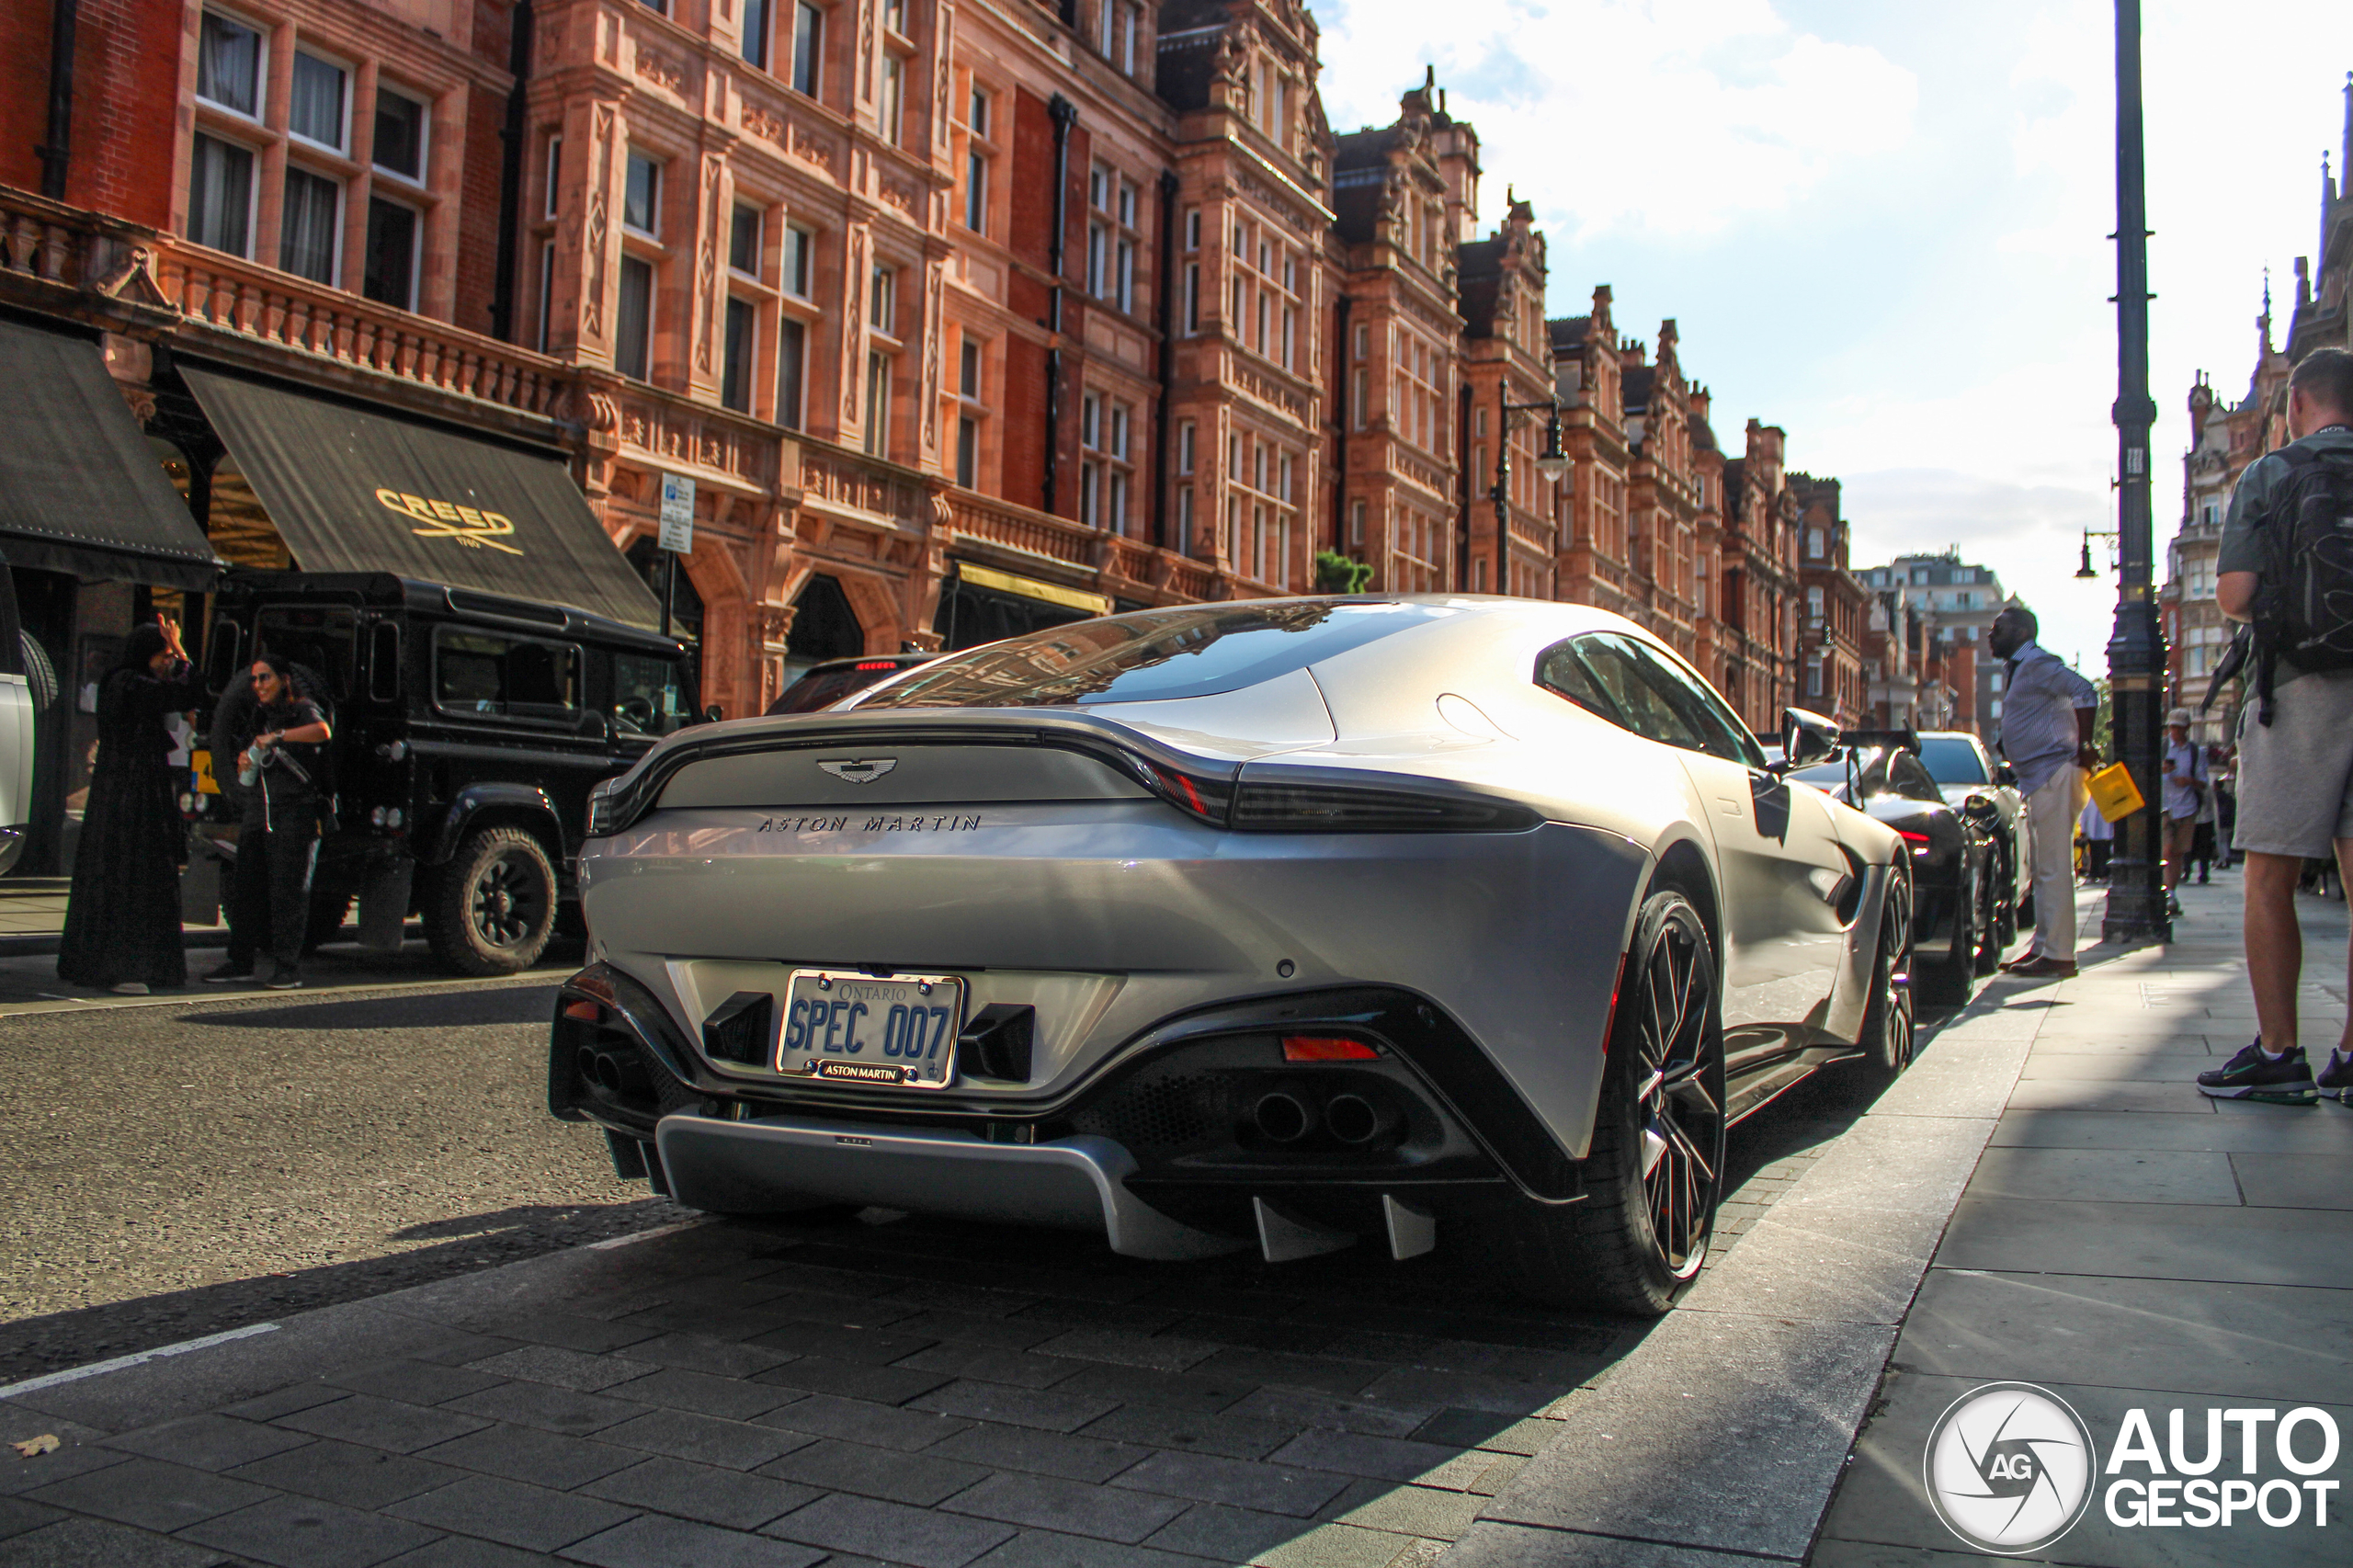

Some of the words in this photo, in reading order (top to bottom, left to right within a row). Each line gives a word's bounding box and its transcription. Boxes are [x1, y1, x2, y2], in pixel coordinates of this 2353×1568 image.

[375, 488, 524, 555] CREED
[757, 816, 848, 832] ASTON
[862, 815, 982, 832] MARTIN
[839, 983, 906, 1003] ONTARIO
[787, 998, 869, 1053] SPEC
[884, 1005, 949, 1060] 007
[825, 1065, 859, 1078] ASTON
[858, 1067, 896, 1081] MARTIN
